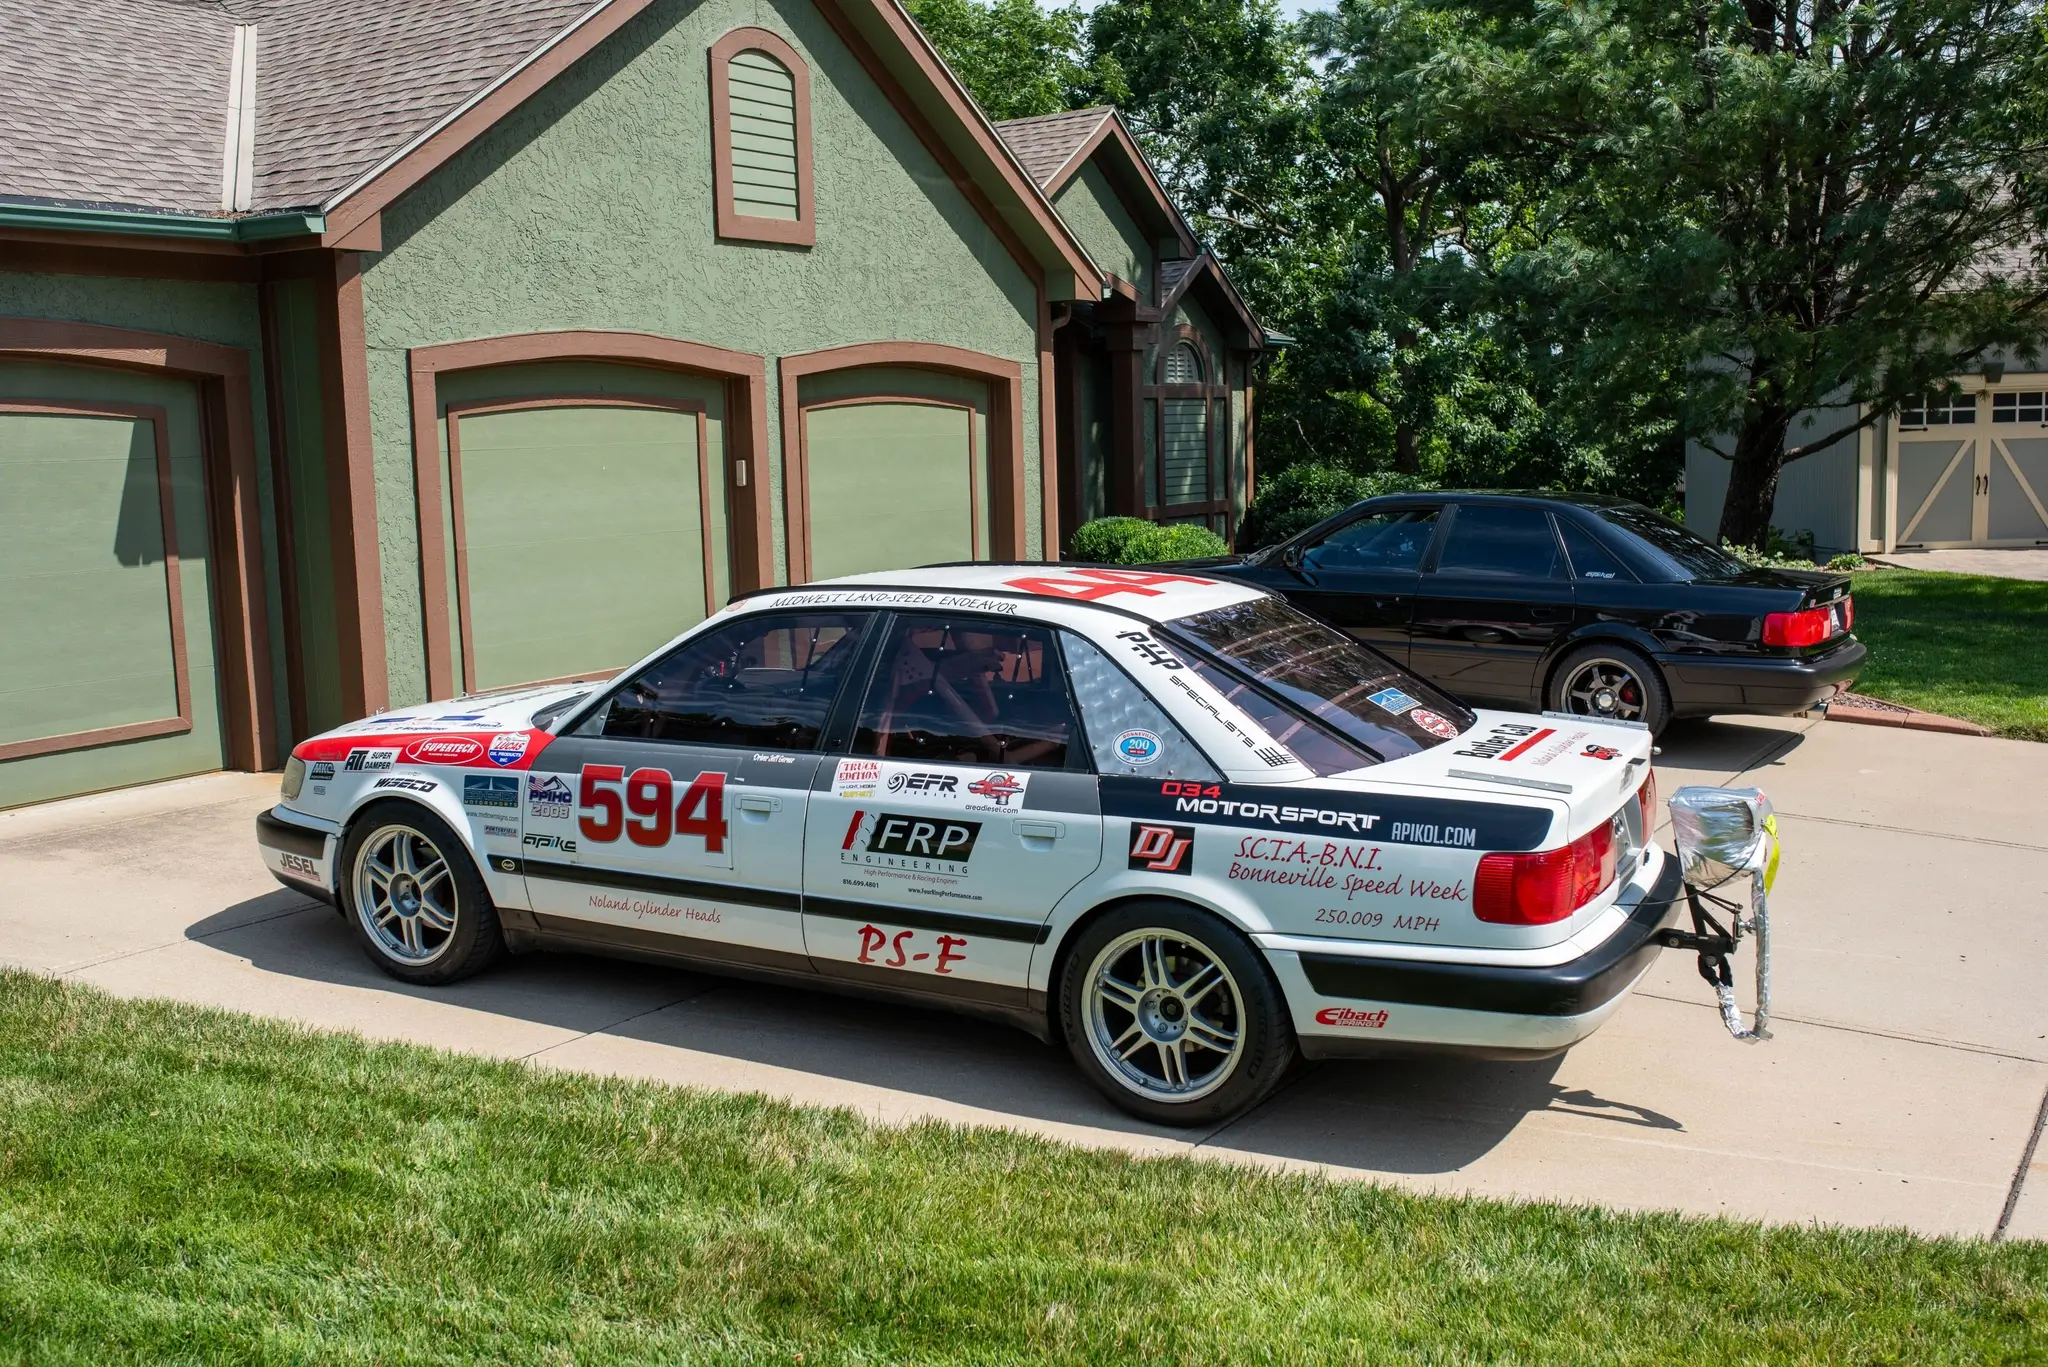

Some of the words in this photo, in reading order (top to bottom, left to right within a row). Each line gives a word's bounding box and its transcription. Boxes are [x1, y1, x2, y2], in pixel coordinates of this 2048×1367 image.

[770, 593, 844, 608] MIDWEST
[845, 593, 934, 604] LAND-SPEED
[938, 596, 1018, 615] ENDEAVOR
[1169, 675, 1256, 748] SPECIALISTS
[494, 741, 526, 750] LUCAS
[1122, 732, 1155, 741] BONNEVILLE
[1128, 739, 1150, 749] 200
[371, 752, 393, 760] SUPER
[422, 743, 478, 754] SUPERTECH
[1453, 735, 1519, 759] Butler
[345, 750, 369, 771] ATI
[364, 762, 391, 770] DAMPER
[843, 762, 878, 771] TRUCK
[838, 771, 880, 782] EDITION
[906, 773, 959, 793] EFR
[464, 790, 518, 801] COHESION
[904, 790, 958, 799] SERIES
[1161, 781, 1221, 799] 034
[464, 800, 519, 808] MOTORSPORTS
[531, 804, 569, 819] 2008
[578, 763, 728, 855] 594
[965, 803, 1019, 815] areadiesel.com
[1176, 797, 1381, 832] MOTORSPORT
[878, 819, 969, 856] FRP
[1391, 822, 1477, 847] APIKOL.COM
[1130, 825, 1193, 871] DJ
[280, 852, 320, 877] JESEL
[840, 852, 969, 875] ENGINEERING
[842, 878, 879, 889] 816.699.4801
[864, 868, 876, 876] High
[877, 870, 911, 882] Performance
[917, 875, 936, 885] Racing
[936, 877, 958, 886] Engines
[1228, 861, 1339, 889] Bonneville
[1342, 873, 1404, 900] Speed
[1410, 878, 1469, 901] Week
[589, 895, 631, 911] Noland
[633, 901, 682, 919] Cylinder
[685, 907, 721, 923] Heads
[1314, 908, 1383, 928] 250.009
[1393, 914, 1441, 932] MPH
[857, 924, 968, 974] PS-E
[1315, 1007, 1389, 1026] Eibach
[1335, 1019, 1380, 1028] SPRINGS
